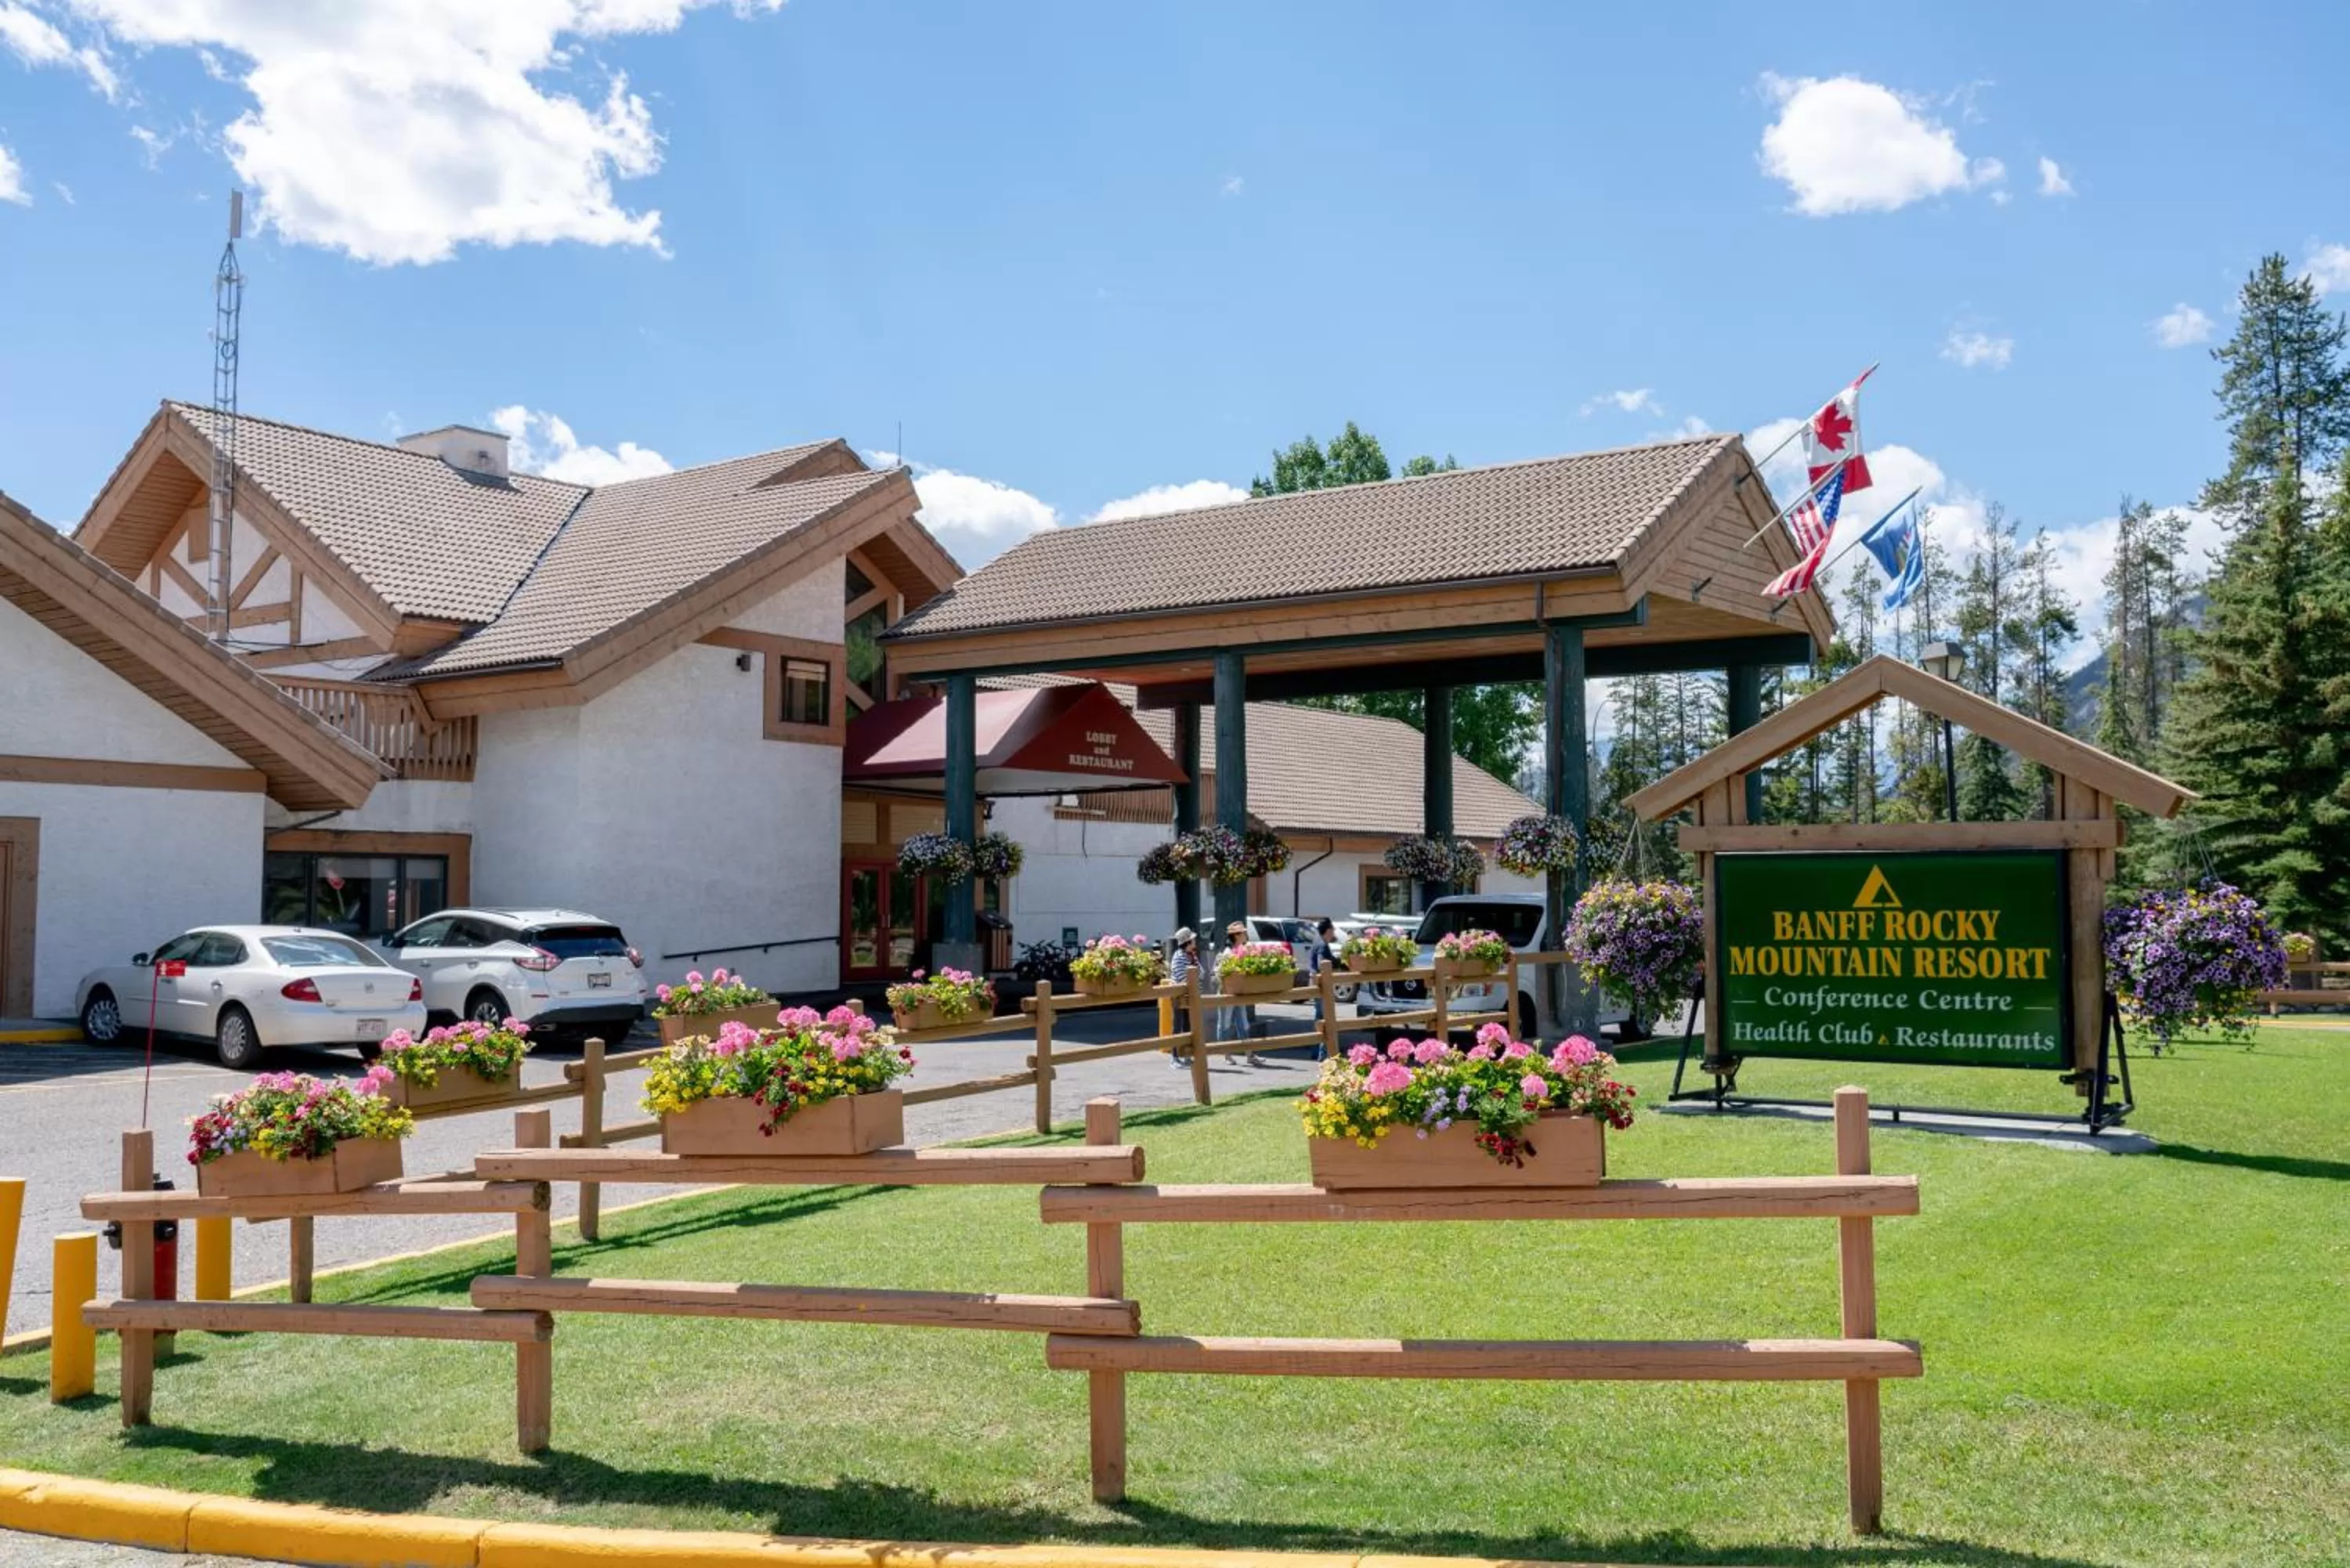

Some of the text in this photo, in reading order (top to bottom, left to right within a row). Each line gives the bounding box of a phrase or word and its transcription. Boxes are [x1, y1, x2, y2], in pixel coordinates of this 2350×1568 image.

[1086, 731, 1117, 745] LOBBY
[1068, 754, 1134, 770] RESTAURANT
[1773, 909, 2001, 941] BANFF ROCKY
[1729, 945, 2051, 979] MOUNTAIN RESORT
[1764, 985, 2013, 1015] Conference Centre
[1732, 1021, 2055, 1052] Health Club Restaurants
